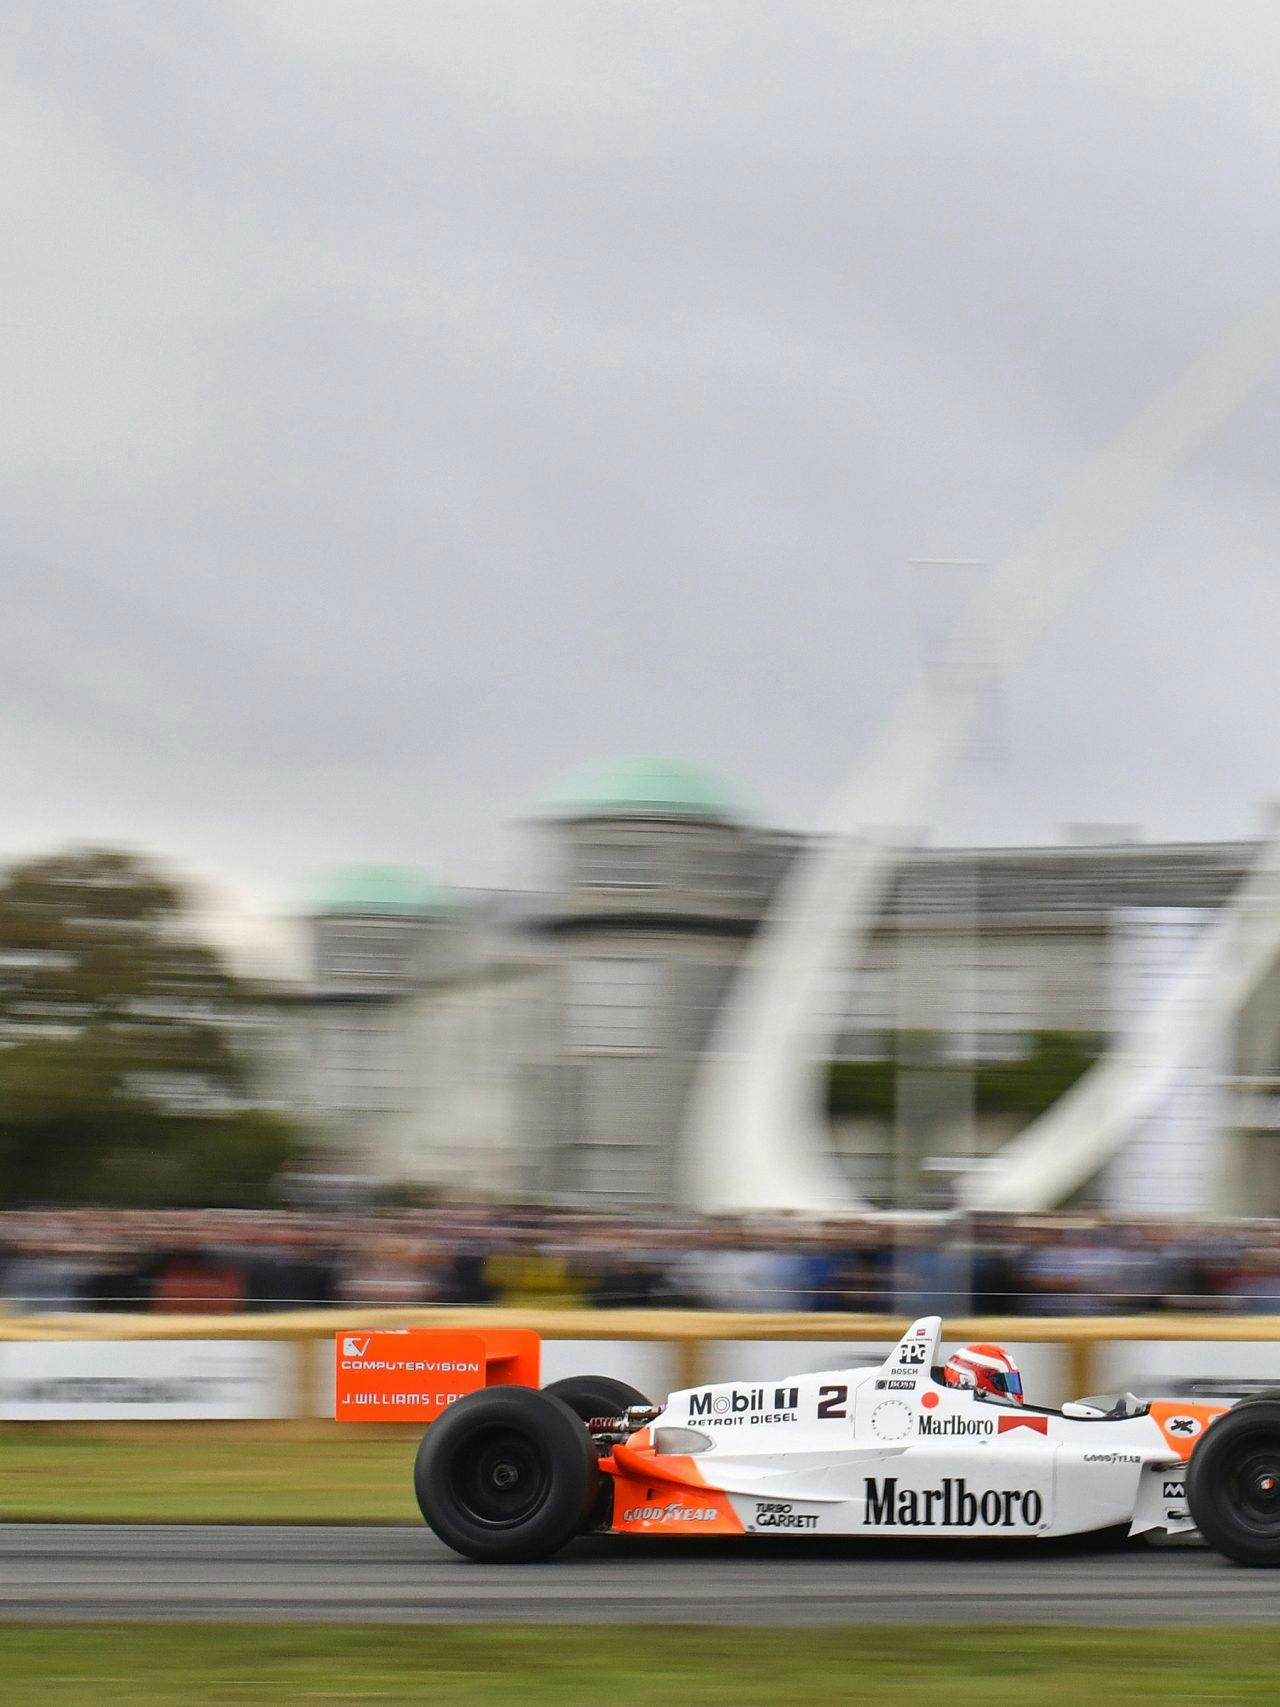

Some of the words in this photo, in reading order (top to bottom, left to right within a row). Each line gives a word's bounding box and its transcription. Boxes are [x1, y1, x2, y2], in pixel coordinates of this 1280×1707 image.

[341, 1361, 479, 1371] COMPUTERVISION
[689, 1389, 763, 1416] Mobil
[817, 1385, 848, 1419] 2
[688, 1416, 744, 1426] DETROIT
[750, 1413, 798, 1424] DIESEL
[918, 1415, 994, 1435] Marlboro
[756, 1503, 793, 1514] TURBO
[863, 1477, 1042, 1526] Marlboro
[756, 1514, 819, 1528] GARRETT
